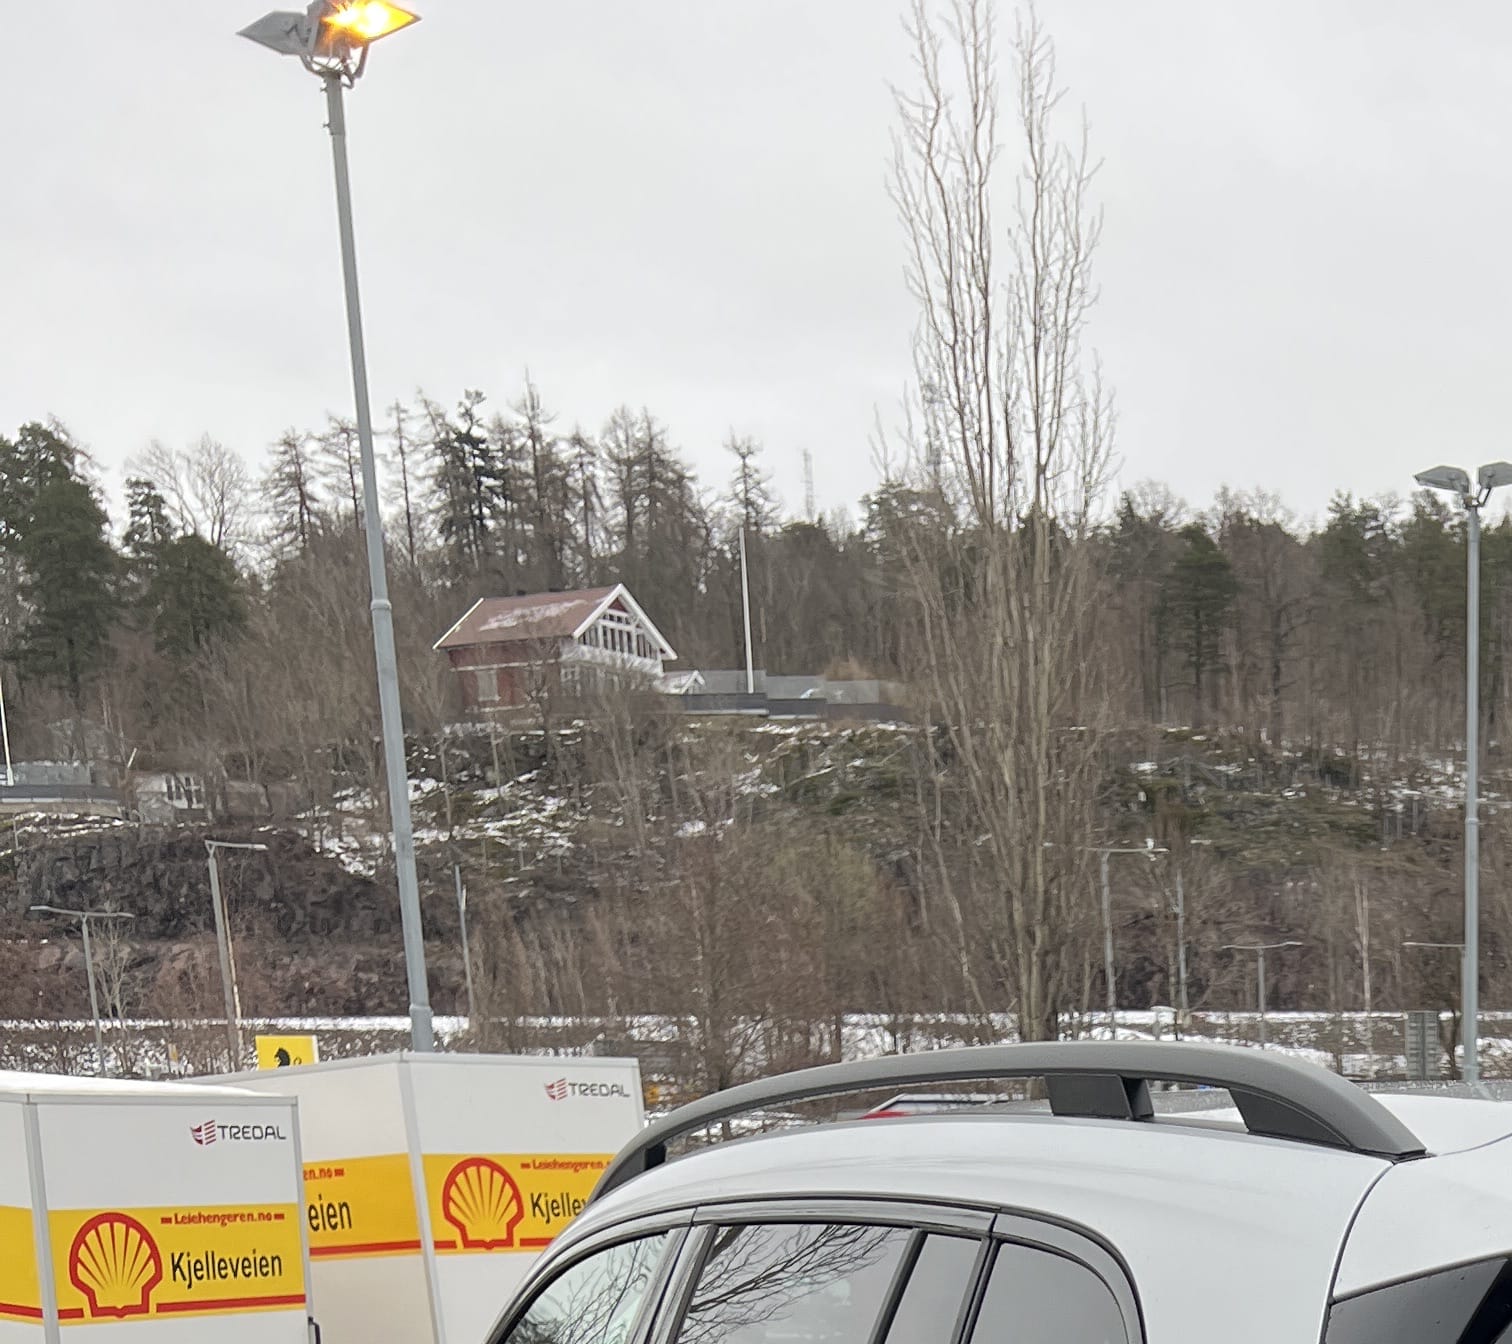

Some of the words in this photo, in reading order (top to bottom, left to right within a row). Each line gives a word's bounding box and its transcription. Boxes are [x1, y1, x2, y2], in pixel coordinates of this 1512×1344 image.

[568, 1082, 631, 1098] TREDAL
[216, 1125, 287, 1141] TREDAL
[170, 1248, 283, 1290] Kjelleveien
